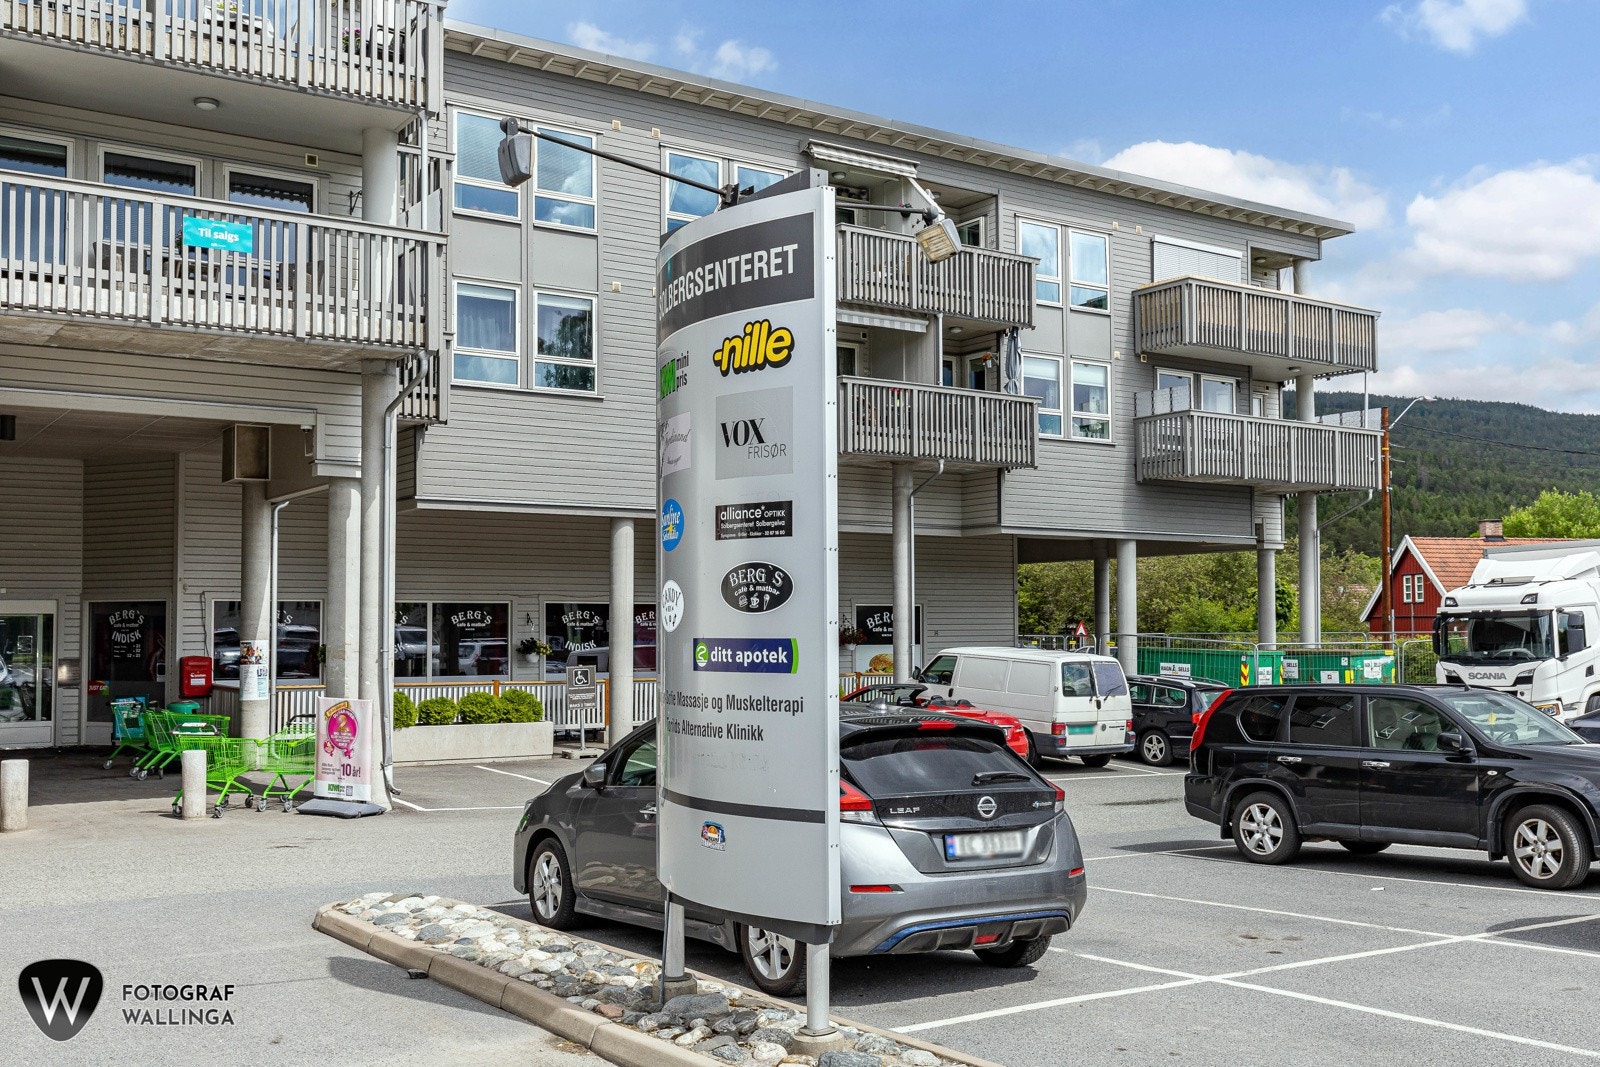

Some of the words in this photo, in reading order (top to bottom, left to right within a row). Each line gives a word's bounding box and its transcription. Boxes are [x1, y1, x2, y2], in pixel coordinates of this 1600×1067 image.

[198, 227, 212, 238] Til
[213, 230, 240, 243] salgs
[713, 319, 795, 377] nille
[720, 417, 766, 448] VOX
[747, 443, 787, 459] FRISØR
[763, 510, 786, 518] OPTIKK
[755, 585, 780, 596] matbar
[111, 629, 142, 644] INDISK
[564, 639, 597, 652] INDISK
[710, 646, 733, 663] ditt
[735, 646, 788, 667] apotek
[1468, 672, 1508, 681] SCANIA
[676, 691, 709, 712] Massasje
[711, 696, 723, 714] og
[726, 694, 804, 716] Muskelterapi
[682, 719, 723, 739] Alternative
[726, 723, 764, 741] Klinikk
[341, 763, 352, 777] 10
[889, 806, 921, 815] LEAF
